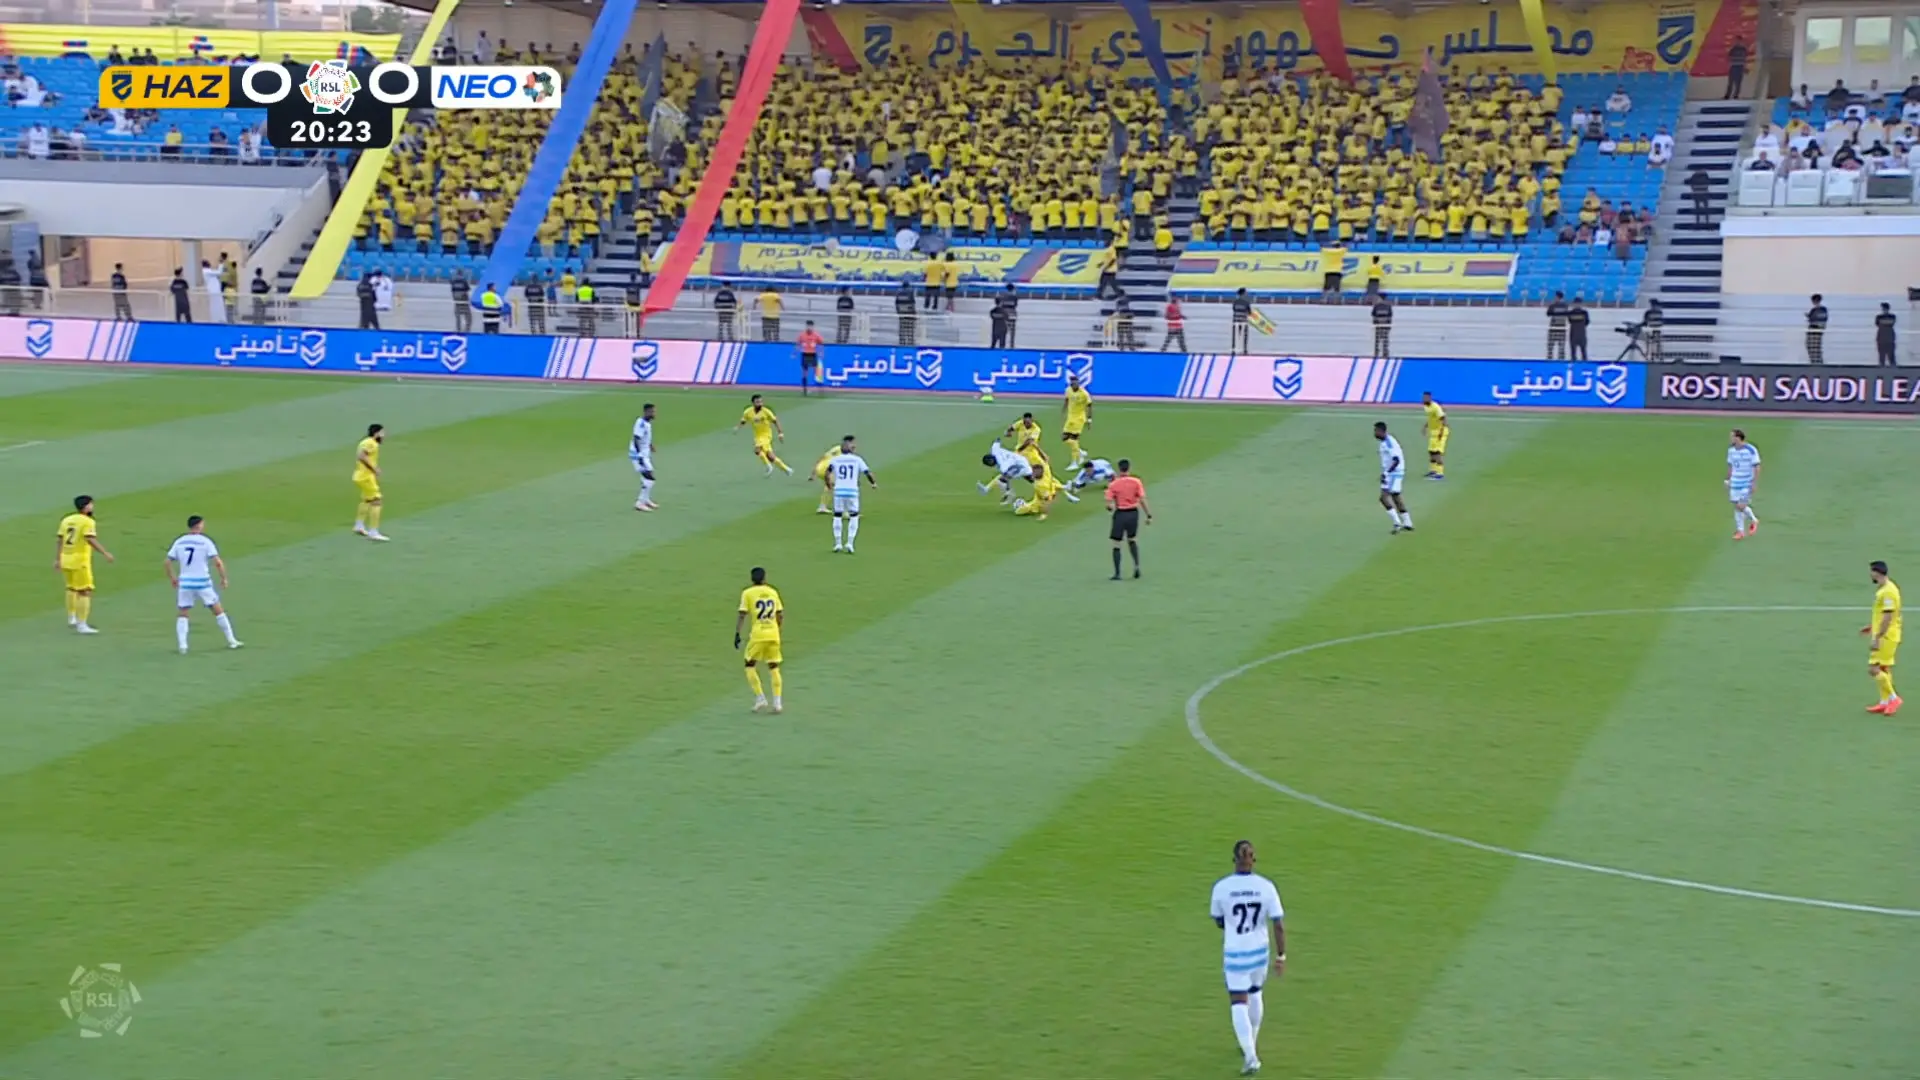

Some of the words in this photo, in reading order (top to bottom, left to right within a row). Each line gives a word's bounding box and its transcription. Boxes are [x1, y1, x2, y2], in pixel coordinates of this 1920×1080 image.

[1234, 29, 1399, 70] جهور
[214, 328, 299, 366] تأميني
[354, 334, 439, 371] تأميني
[825, 349, 914, 386] تأميني
[1491, 363, 1593, 405] تأميني
[1661, 374, 1766, 401] ROSHN
[1774, 376, 1866, 401] SAUDI
[838, 464, 854, 480] 91
[65, 527, 76, 546] 2
[184, 547, 196, 566] 7
[755, 599, 775, 620] 22
[1232, 901, 1262, 935] 27
